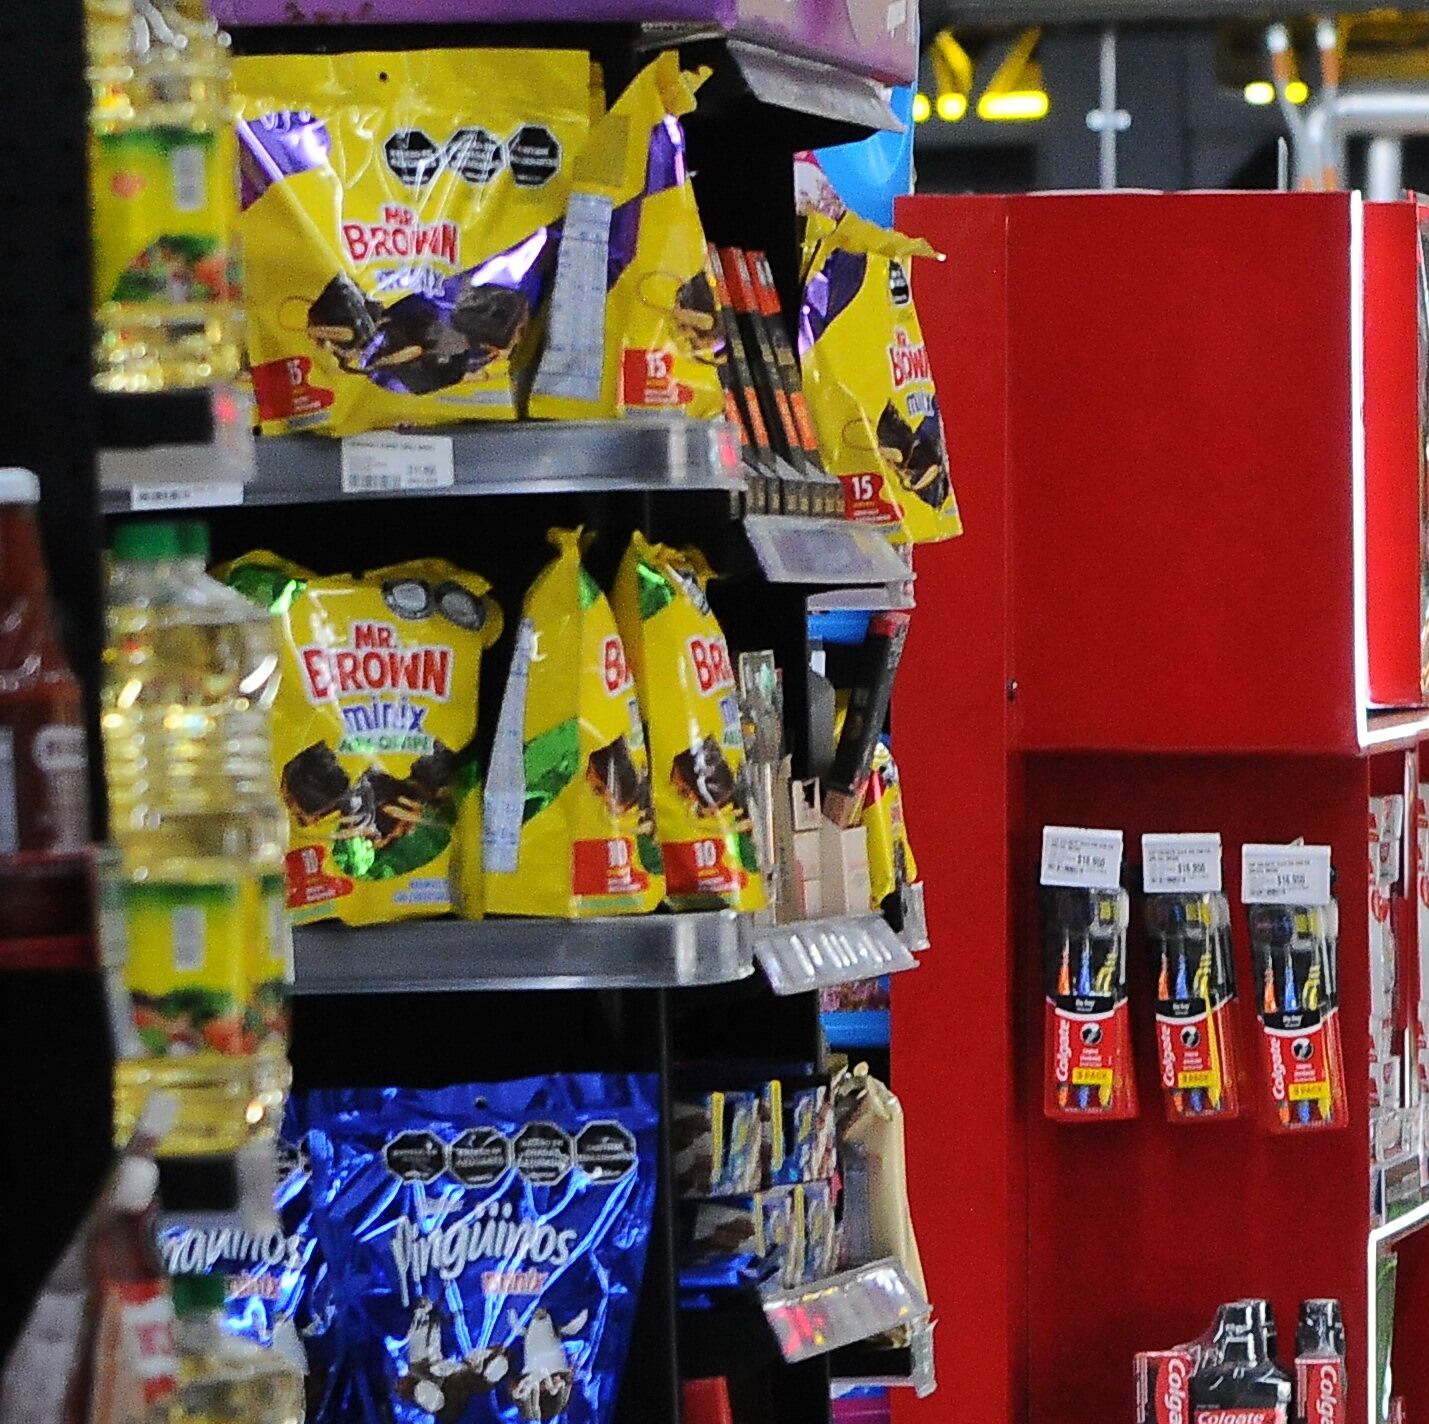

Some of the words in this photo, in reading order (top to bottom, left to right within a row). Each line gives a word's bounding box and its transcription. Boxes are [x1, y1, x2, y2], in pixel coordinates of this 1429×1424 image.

[343, 224, 458, 264] BROWN
[851, 476, 874, 501] 15
[302, 647, 450, 698] BROWN
[1056, 1018, 1072, 1083] Colgate
[1161, 1023, 1176, 1088] Colgate
[1270, 1035, 1286, 1101] Colgate
